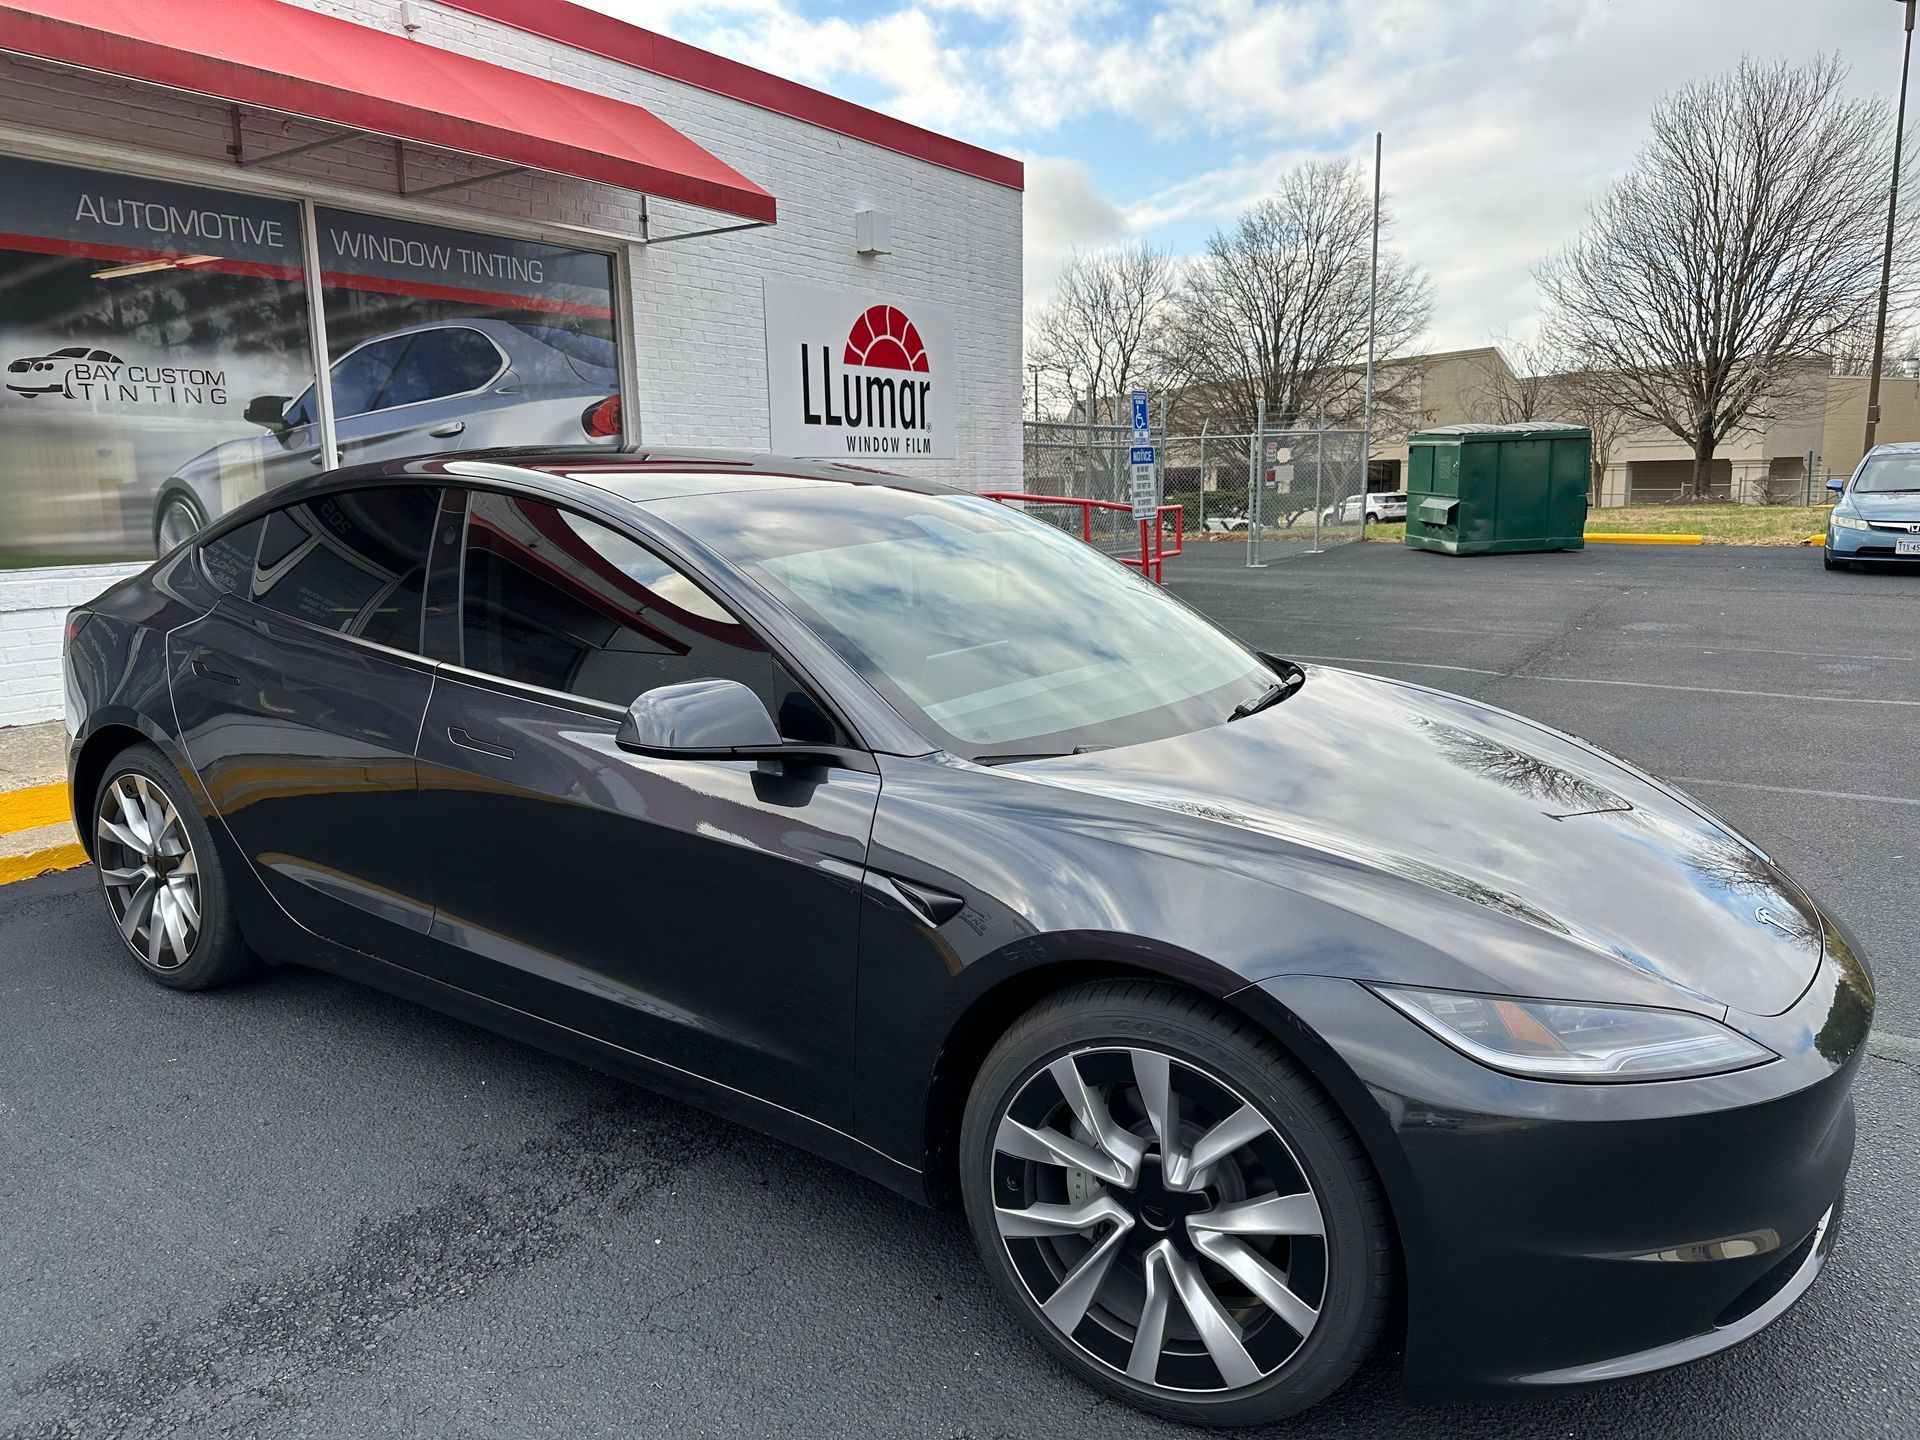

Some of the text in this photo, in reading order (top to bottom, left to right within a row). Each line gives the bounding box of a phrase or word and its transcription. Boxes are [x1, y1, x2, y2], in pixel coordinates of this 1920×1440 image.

[75, 193, 544, 284] AUTOMOTIVE WINDOW TINTING
[74, 363, 227, 386] BAY CUSTOM
[77, 383, 228, 405] TINTING
[846, 435, 931, 454] WINDOW FILM
[1132, 450, 1152, 462] NOTICE
